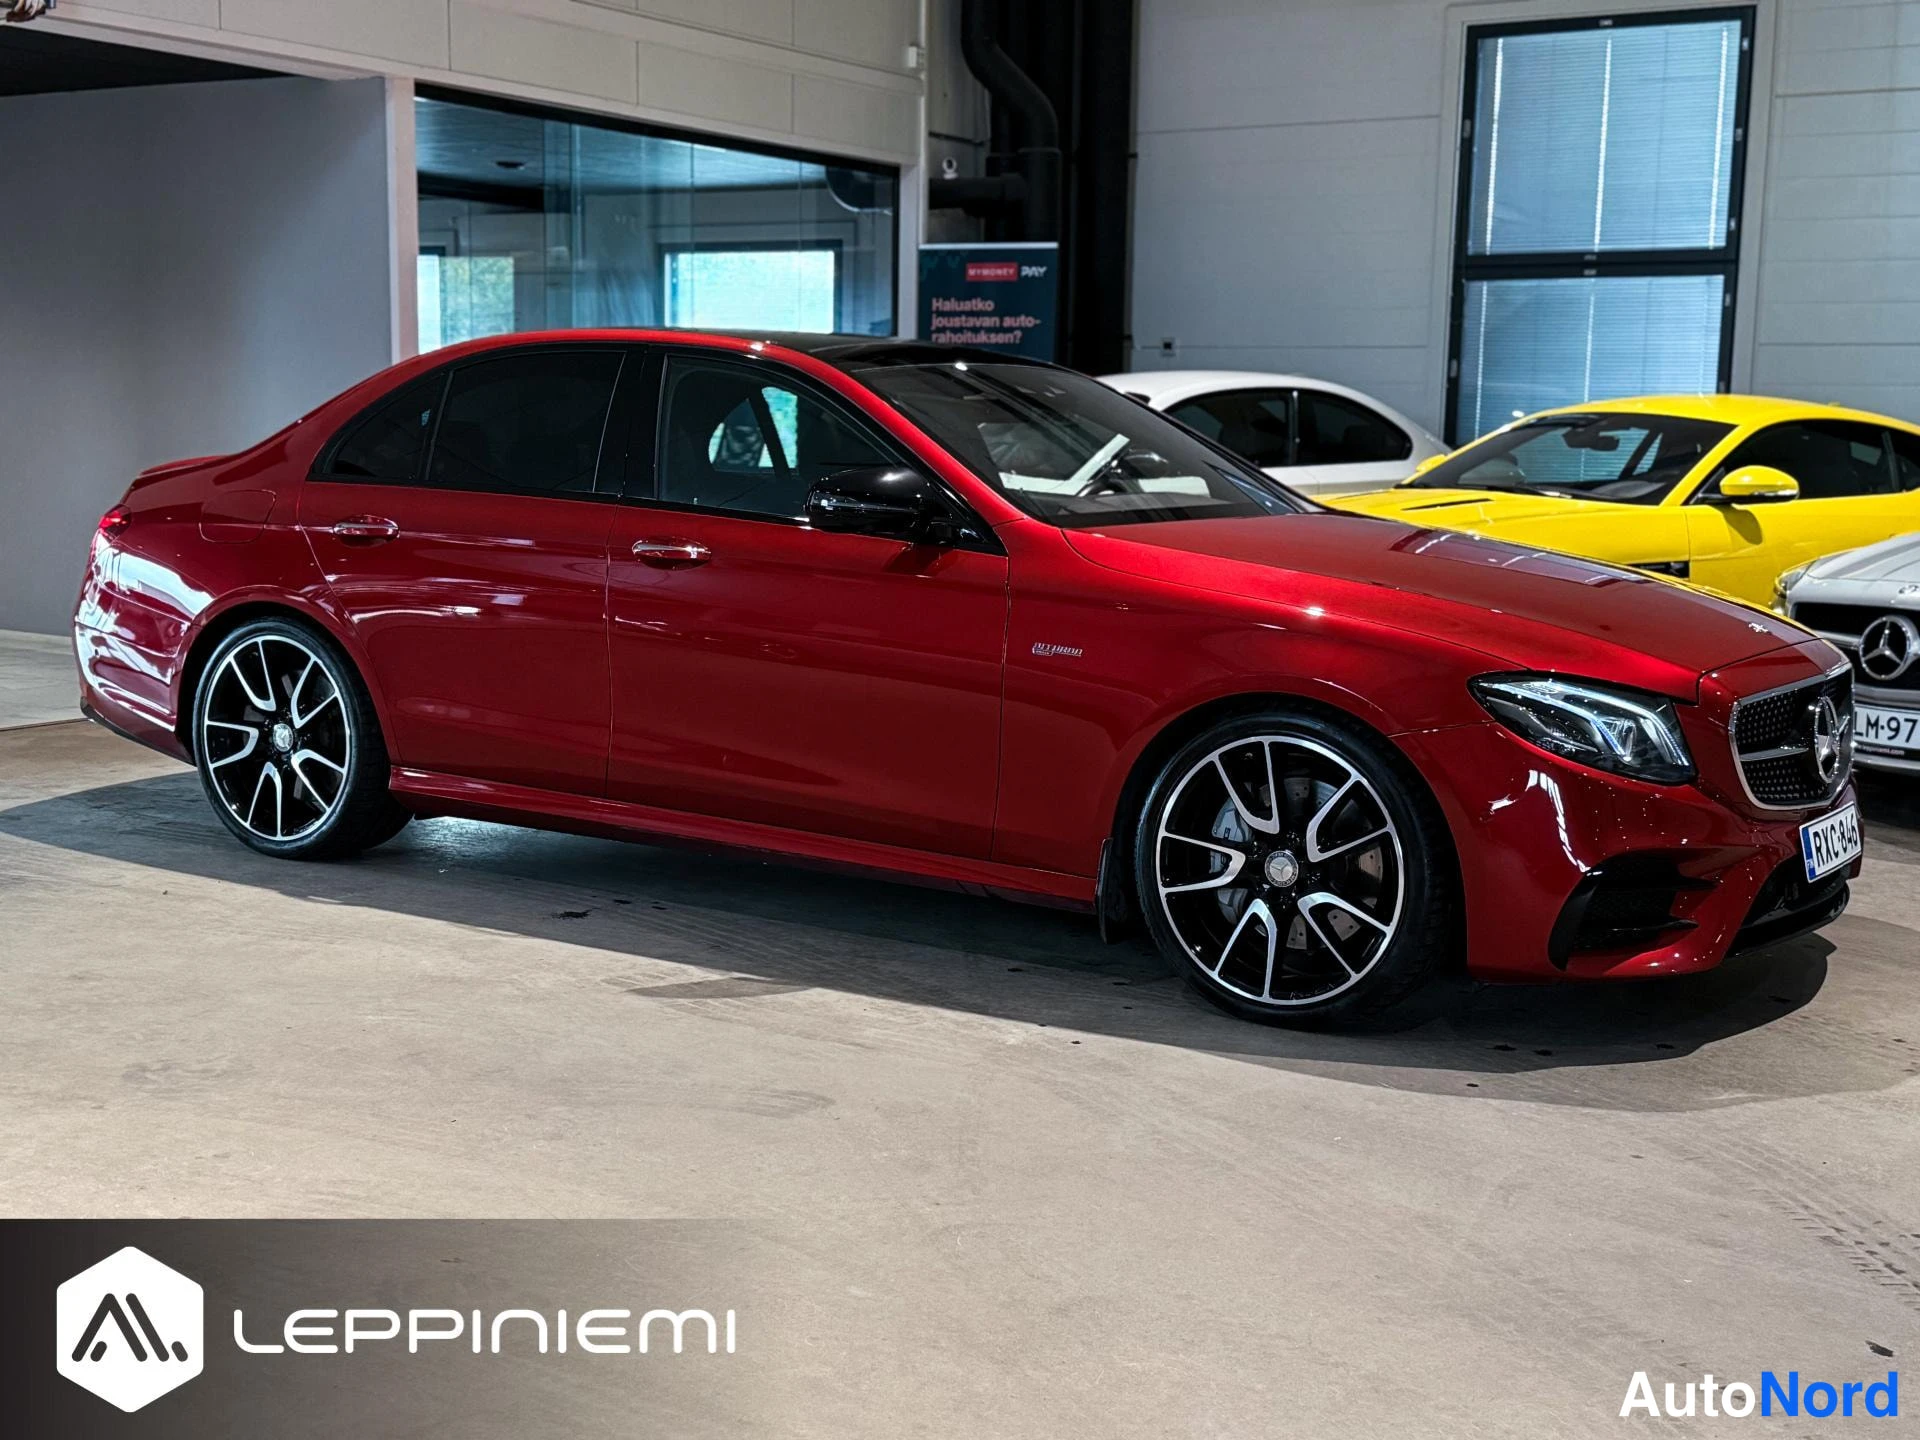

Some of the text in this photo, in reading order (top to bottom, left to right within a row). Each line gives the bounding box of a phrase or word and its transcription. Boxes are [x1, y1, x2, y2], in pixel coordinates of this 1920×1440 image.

[1020, 266, 1047, 277] PAY
[931, 297, 995, 311] Haluatko
[930, 314, 1042, 330] joustavan auto-
[931, 330, 1023, 344] rahoituksen?
